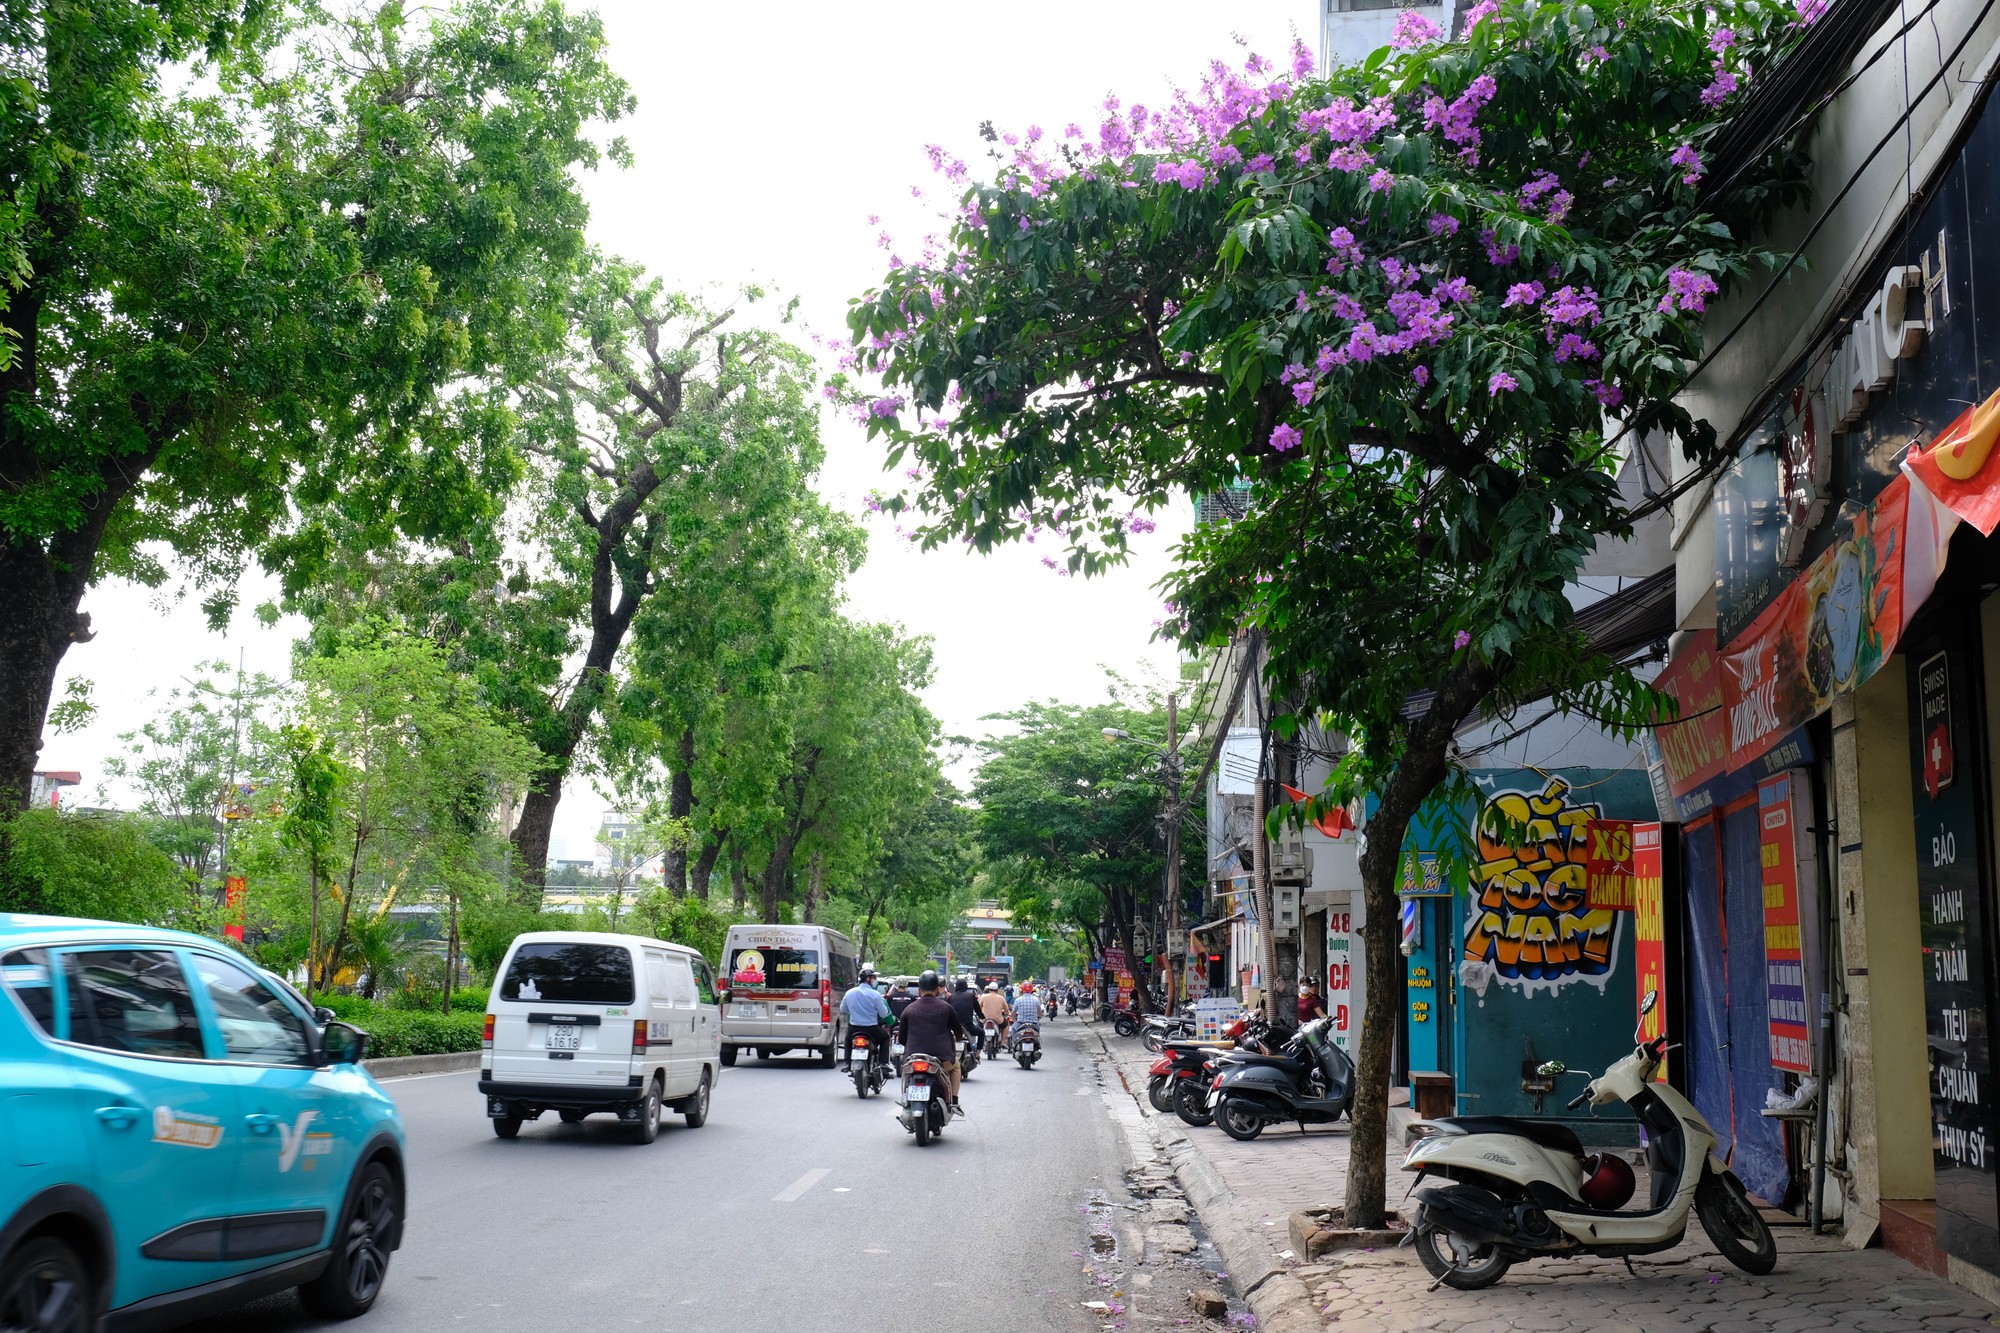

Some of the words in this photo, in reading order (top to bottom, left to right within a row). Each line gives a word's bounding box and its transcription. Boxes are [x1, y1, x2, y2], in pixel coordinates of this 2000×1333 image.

[1923, 666, 1945, 695] SWISS
[1926, 693, 1946, 720] MADE
[1592, 824, 1634, 862] XÔ
[1932, 823, 1956, 867] BẢO
[1469, 857, 1588, 912] TÓC
[1591, 867, 1622, 905] BÁNH
[1635, 863, 1663, 942] SÁCH
[1932, 885, 1964, 925] HÀNH
[1464, 909, 1613, 966] NAM
[1329, 955, 1350, 990] CẦ
[1935, 951, 1942, 982] 5
[1943, 943, 1968, 982] NĂM
[1408, 978, 1432, 989] NHUỘM
[1942, 1001, 1967, 1043] TIÊU
[1938, 1054, 1978, 1105] CHUẨN
[1938, 1124, 1966, 1168] THỤY
[1970, 1126, 1985, 1169] SỸ
